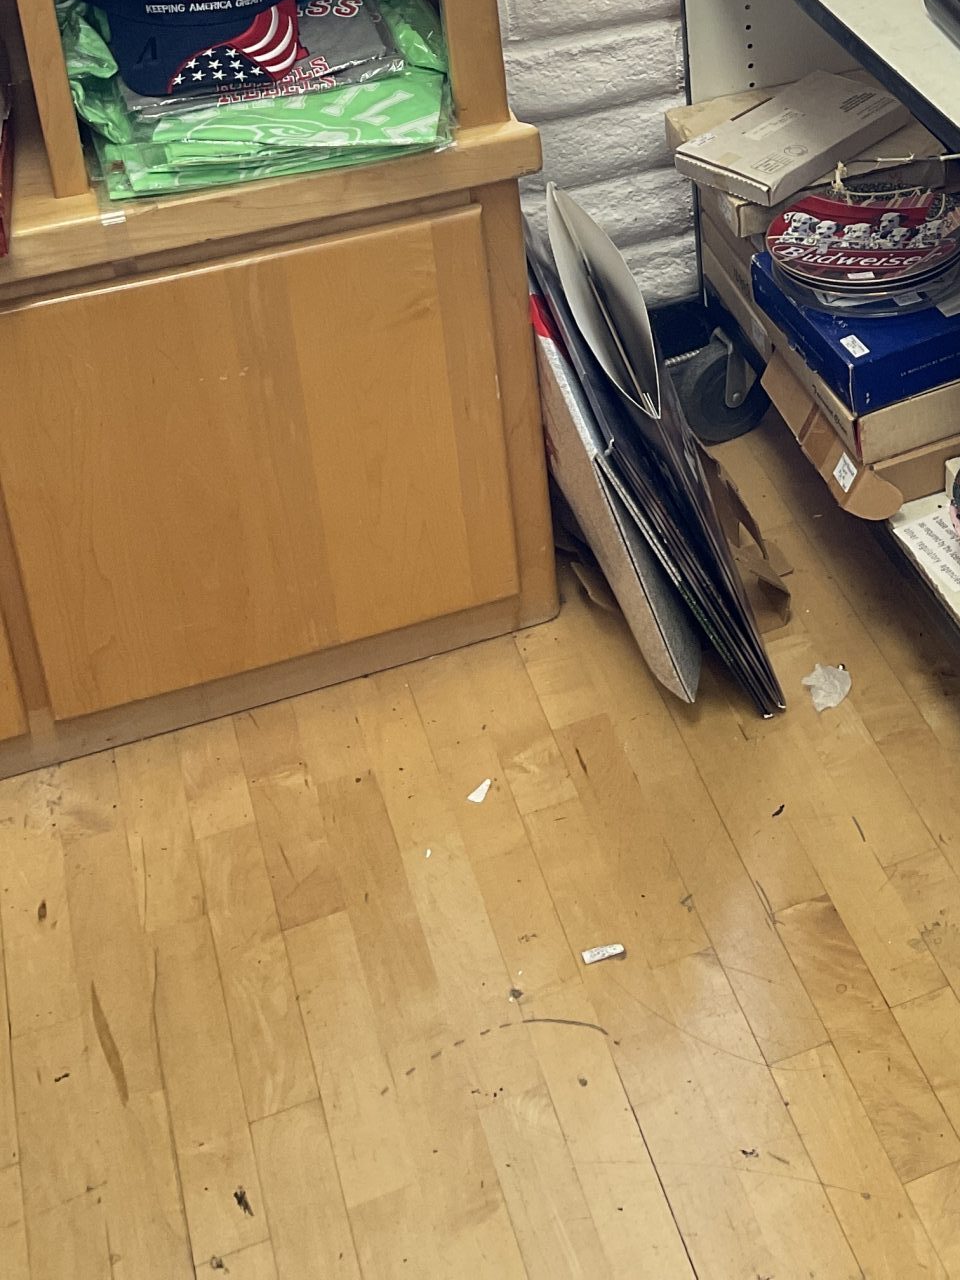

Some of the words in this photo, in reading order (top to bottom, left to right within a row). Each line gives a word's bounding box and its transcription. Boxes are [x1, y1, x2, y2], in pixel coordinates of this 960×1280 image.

[145, 2, 186, 15] KEEPING
[189, 0, 233, 13] AMERICA
[777, 245, 943, 267] Budweiser
[903, 527, 918, 540] other
[916, 541, 941, 563] regulatory
